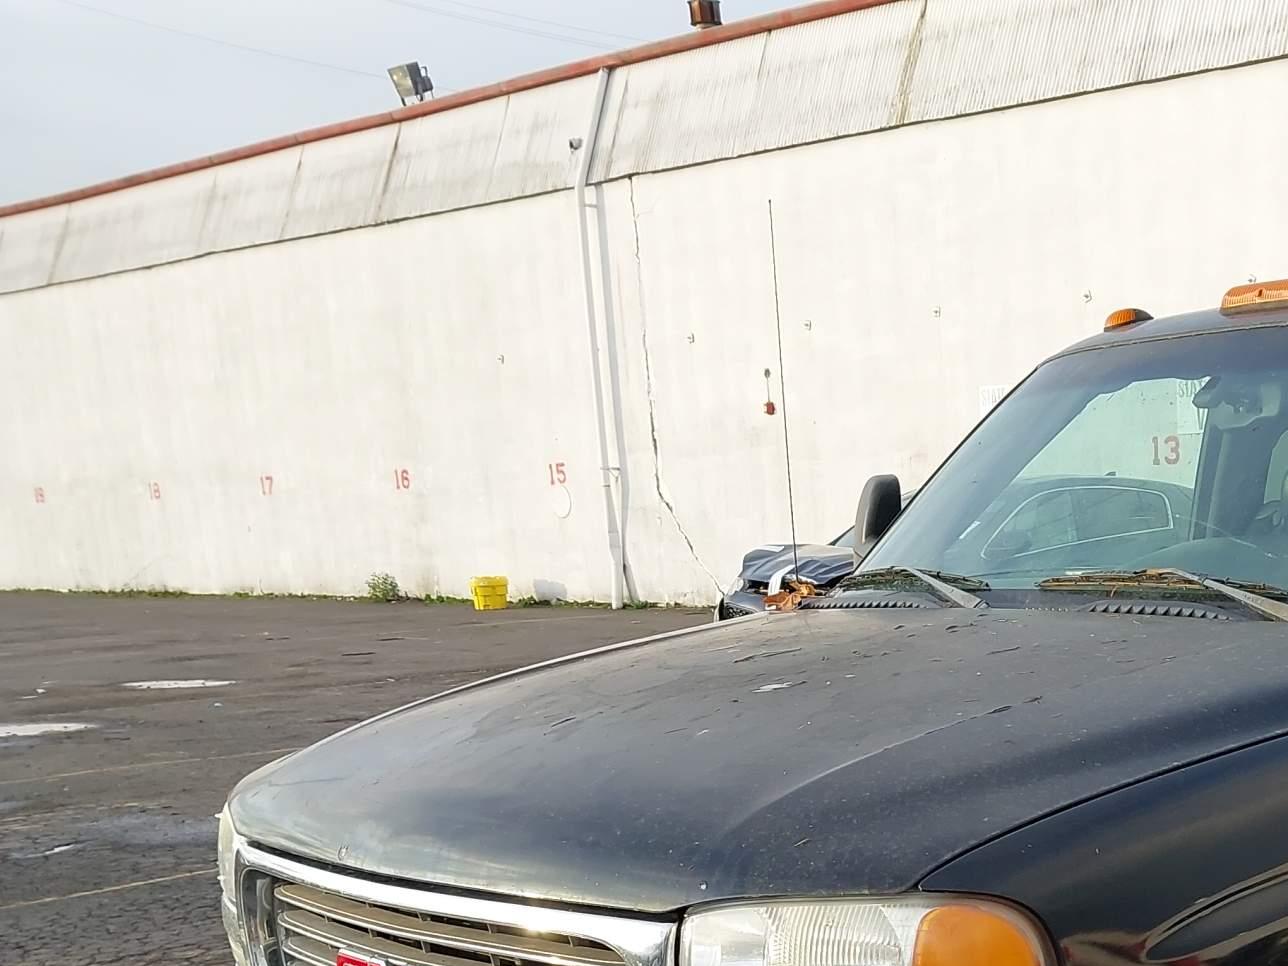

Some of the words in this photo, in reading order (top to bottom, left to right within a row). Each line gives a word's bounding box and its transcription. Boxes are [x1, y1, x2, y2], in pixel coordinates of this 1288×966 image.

[1151, 435, 1180, 466] 13
[394, 468, 410, 490] 16
[548, 462, 567, 485] 15
[148, 481, 161, 501] 18
[259, 475, 274, 496] 17
